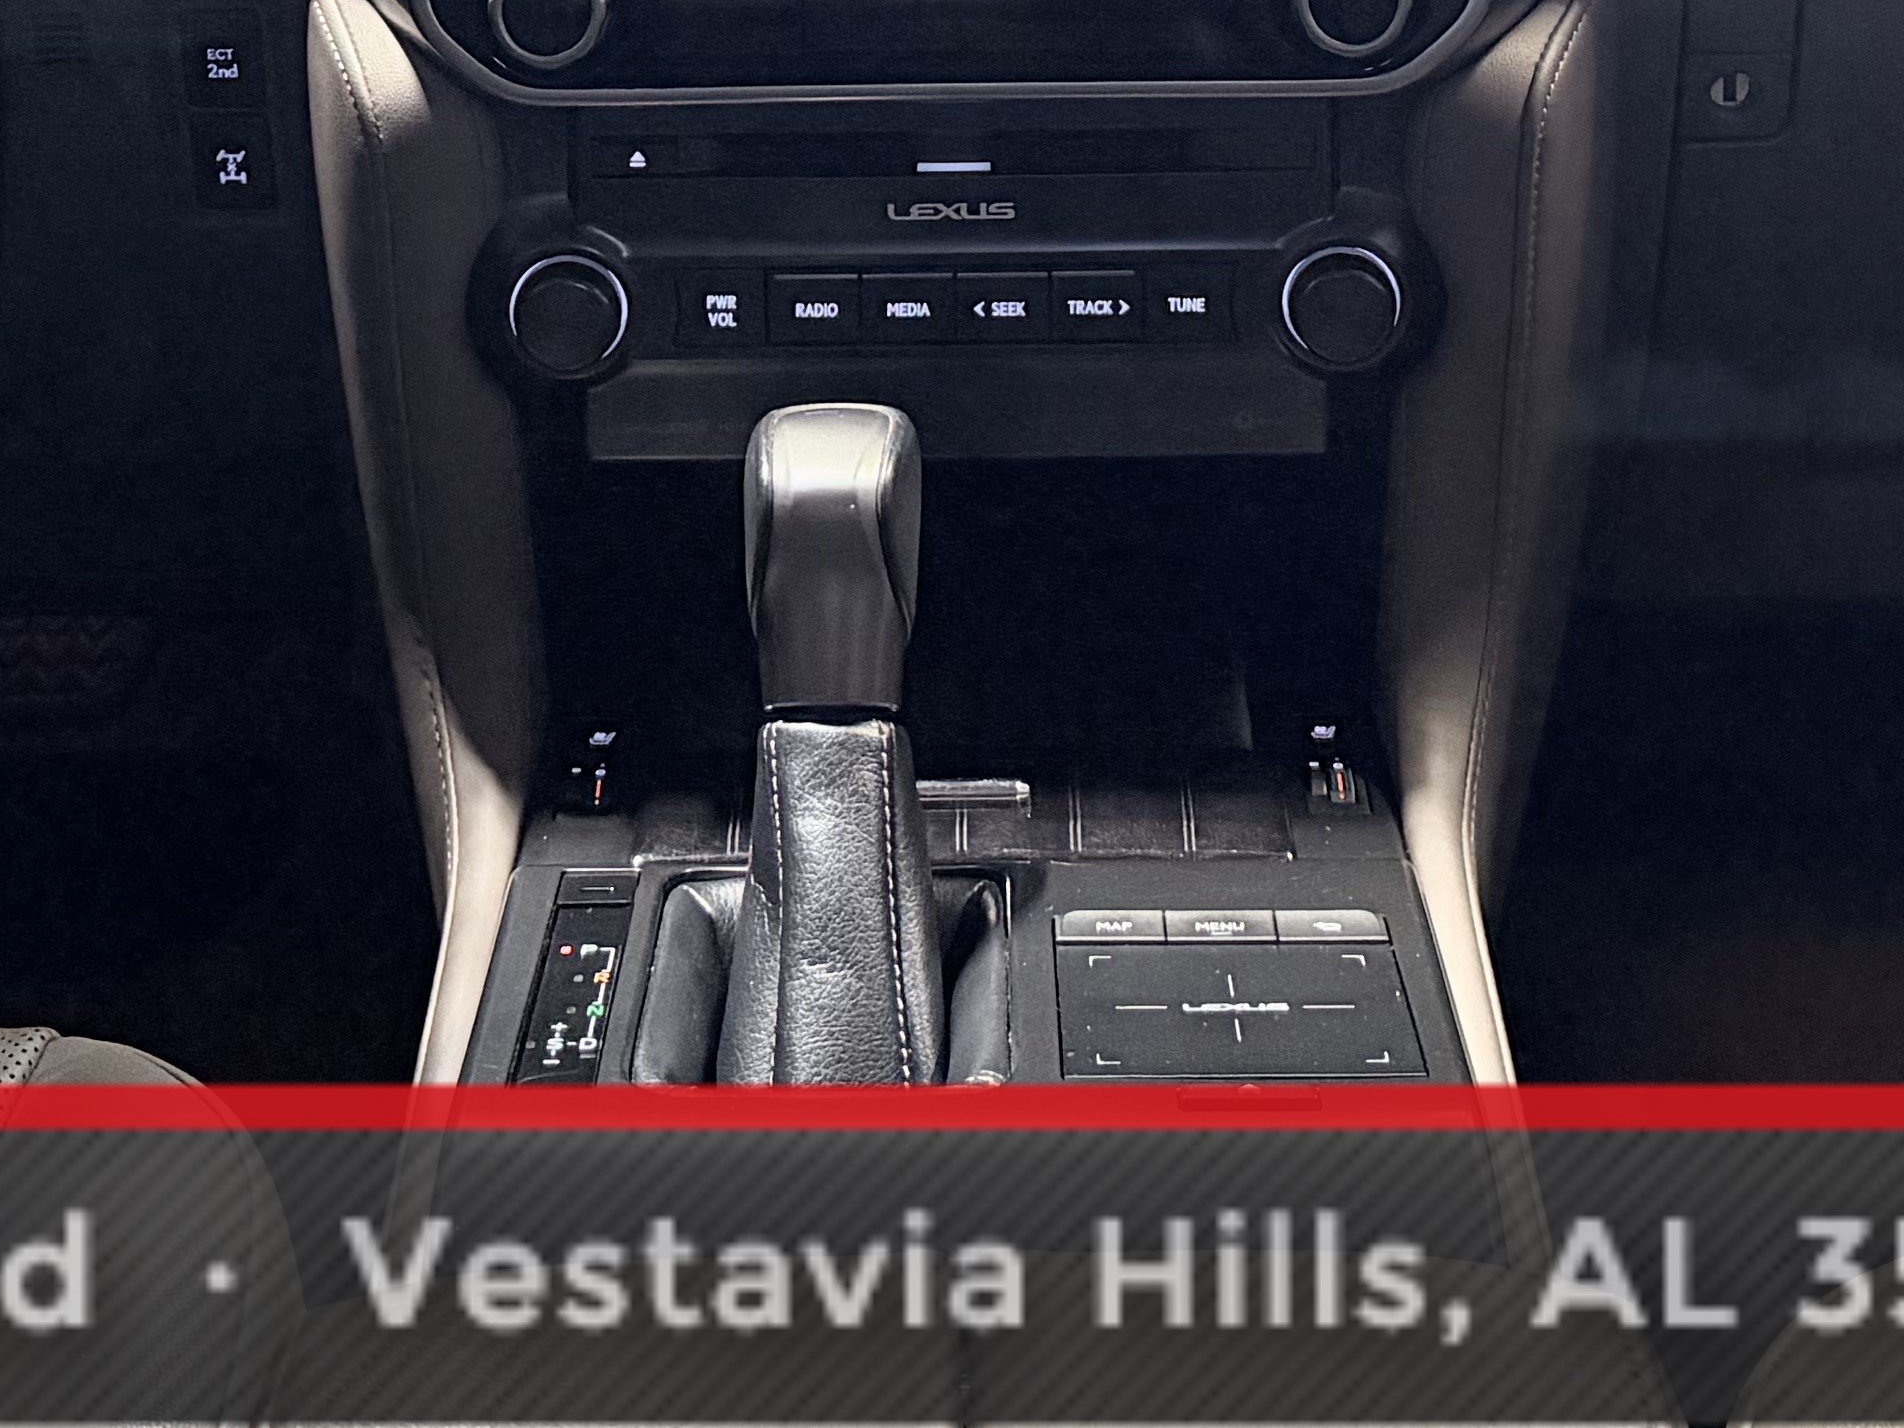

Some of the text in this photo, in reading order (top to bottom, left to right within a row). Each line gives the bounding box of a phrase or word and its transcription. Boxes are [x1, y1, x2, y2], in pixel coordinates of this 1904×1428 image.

[206, 48, 234, 62] ECT
[207, 63, 239, 79] 2nd
[886, 201, 1017, 221] LEXUS
[706, 294, 737, 310] PWR
[886, 301, 931, 318] MEDIA
[991, 301, 1027, 318] SEEK
[1067, 299, 1114, 316] TRACK
[1167, 296, 1206, 313] TUNE
[795, 302, 839, 319] RADIO
[708, 312, 738, 328] VOL
[1096, 920, 1133, 933] MAP
[1194, 920, 1245, 933] MENU
[579, 1036, 598, 1051] D
